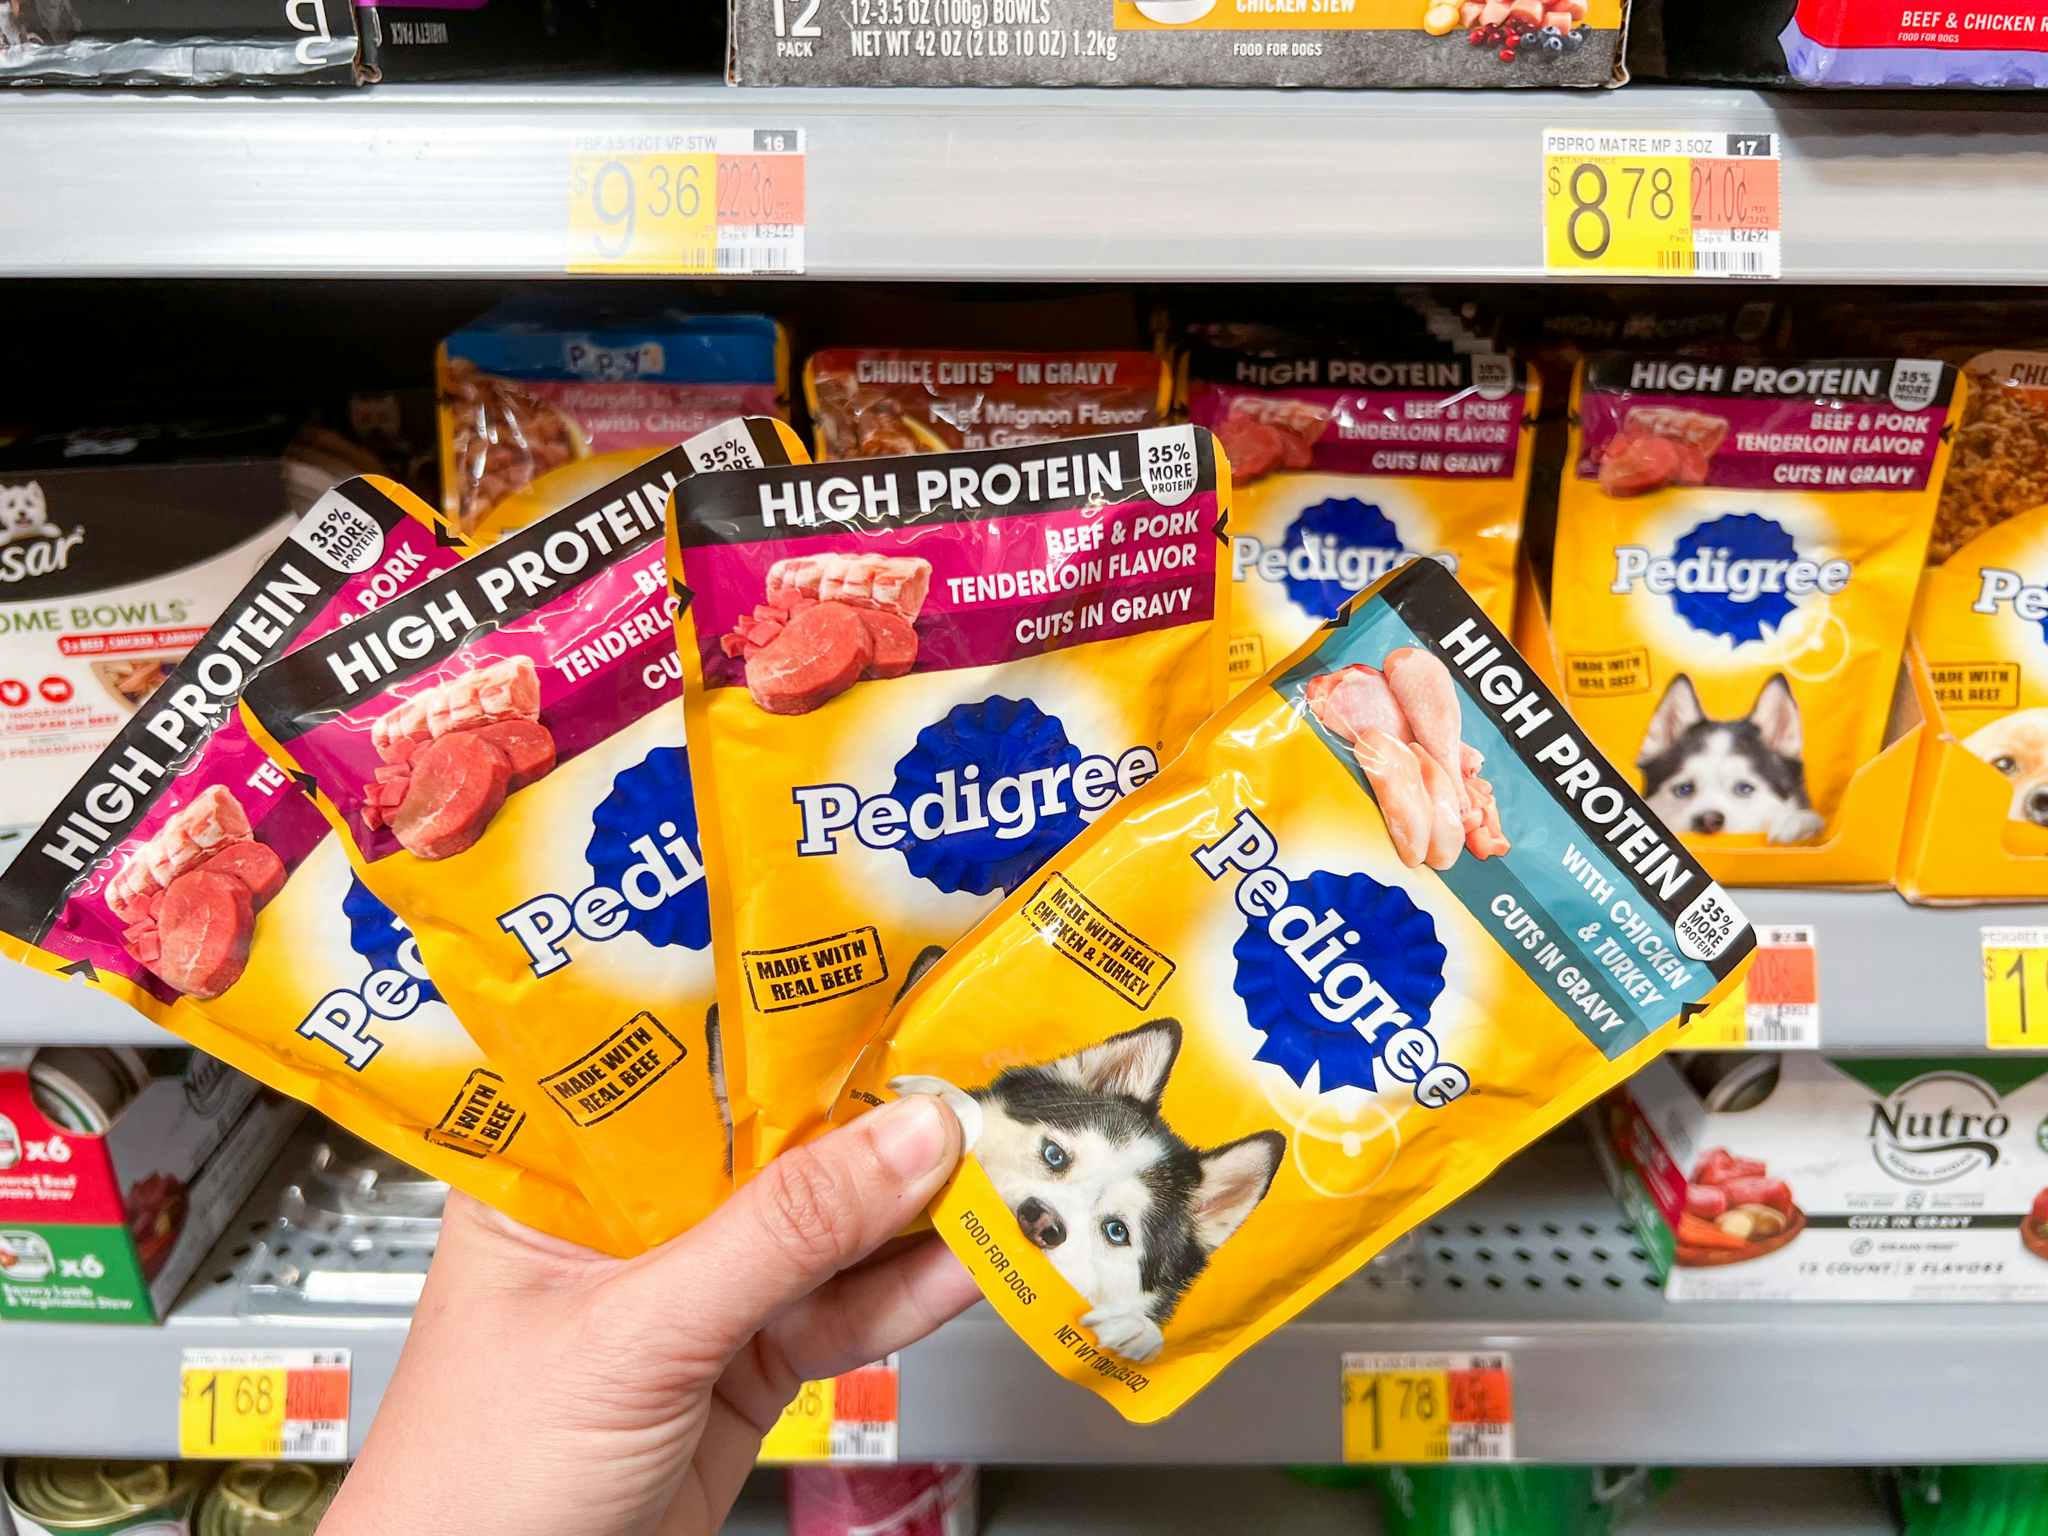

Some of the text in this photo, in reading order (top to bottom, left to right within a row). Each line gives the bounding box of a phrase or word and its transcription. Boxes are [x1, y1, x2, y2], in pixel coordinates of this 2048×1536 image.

[908, 0, 929, 24] OZ
[935, 0, 989, 30] (100g)
[994, 0, 1051, 24] BOWLS
[1312, 0, 1355, 13] STEW
[1901, 11, 2035, 32] BEEF & CHICKEN
[390, 22, 414, 44] PACK
[776, 42, 813, 57] PACK
[851, 30, 1118, 61] NET WT 42 OZ (2 LB 10 OZ) 1.2kg
[1233, 43, 1322, 56] FOOD FOR DOGS
[1898, 33, 1960, 43] FOOD FOR DOGS
[688, 136, 718, 150] STW
[763, 137, 785, 151] 16
[1548, 137, 1595, 151] PBPRO
[1600, 138, 1648, 152] MATRE
[1651, 140, 1671, 152] MP
[1736, 141, 1758, 155] 17
[592, 160, 637, 259] 9
[648, 164, 700, 217] 36
[1548, 163, 1674, 260] $ 8 78
[857, 360, 933, 384] CHOICE
[1017, 363, 1042, 384] IN
[1045, 363, 1118, 385] GRAVY
[1236, 360, 1317, 386] HIGH
[1327, 361, 1463, 387] PROTEIN
[1630, 361, 1881, 396] HIGH PROTEIN
[1899, 370, 1932, 384] 35%
[986, 404, 1073, 429] Mignon
[1078, 404, 1149, 425] Flavor
[1404, 400, 1512, 421] BEEF & PORK
[1811, 413, 1929, 434] BEEF & PORK
[964, 433, 984, 449] in
[1338, 422, 1508, 444] TENDERLOIN FLAVOR
[1736, 434, 1925, 456] TENDERLOIN FLAVOR
[700, 439, 746, 470] 35%
[1148, 443, 1191, 464] 35%
[1149, 463, 1192, 482] MORE
[1372, 452, 1504, 473] CUTS IN GRAVY
[758, 450, 1123, 528] HIGH PROTEIN
[1773, 467, 1916, 485] CUTS IN GRAVY
[310, 508, 351, 549] 35%
[326, 518, 369, 562] MORE
[1044, 509, 1200, 556] BEEF & PORK
[326, 471, 679, 696] HIGH PROTEIN
[357, 541, 427, 610] PORK
[946, 543, 1198, 605] TENDERLOIN FLAVOR
[1610, 546, 1852, 602] Pedigree
[1014, 587, 1193, 645] CUTS IN GRAVY
[41, 747, 166, 873] HIGH
[146, 563, 322, 754] PROTEIN
[1439, 617, 1694, 904] HIGH PROTEIN
[792, 745, 1160, 858] Pedigree
[1051, 888, 1156, 976] MADE WITH REAL
[1561, 842, 1693, 992] WITH CHICKEN
[1687, 910, 1724, 950] MORE
[1700, 897, 1735, 937] 35%
[756, 940, 868, 982] MADE WITH
[1083, 947, 1096, 962] &
[1095, 952, 1150, 997] TURKEY
[1190, 806, 1470, 1109] Pedigree
[1490, 893, 1626, 1036] CUTS IN GRAVY
[1577, 919, 1666, 1009] & TURKEY
[771, 963, 865, 1004] REAL BEEF
[2005, 953, 2027, 1034] 1
[554, 1026, 654, 1101] MADE WITH
[578, 1049, 662, 1115] REAL BEEF
[454, 1084, 497, 1130] WITH
[480, 1101, 516, 1141] BEEF
[1868, 1101, 2010, 1142] Nutro
[25, 1136, 71, 1162] x6
[59, 1254, 104, 1278] x6
[959, 1209, 1037, 1306] FOOD FOR DOGS
[1053, 1324, 1098, 1363] NET WT
[200, 1376, 216, 1445] 1
[235, 1375, 273, 1415] 68
[1360, 1378, 1382, 1451] 1
[1396, 1378, 1438, 1420] 78
